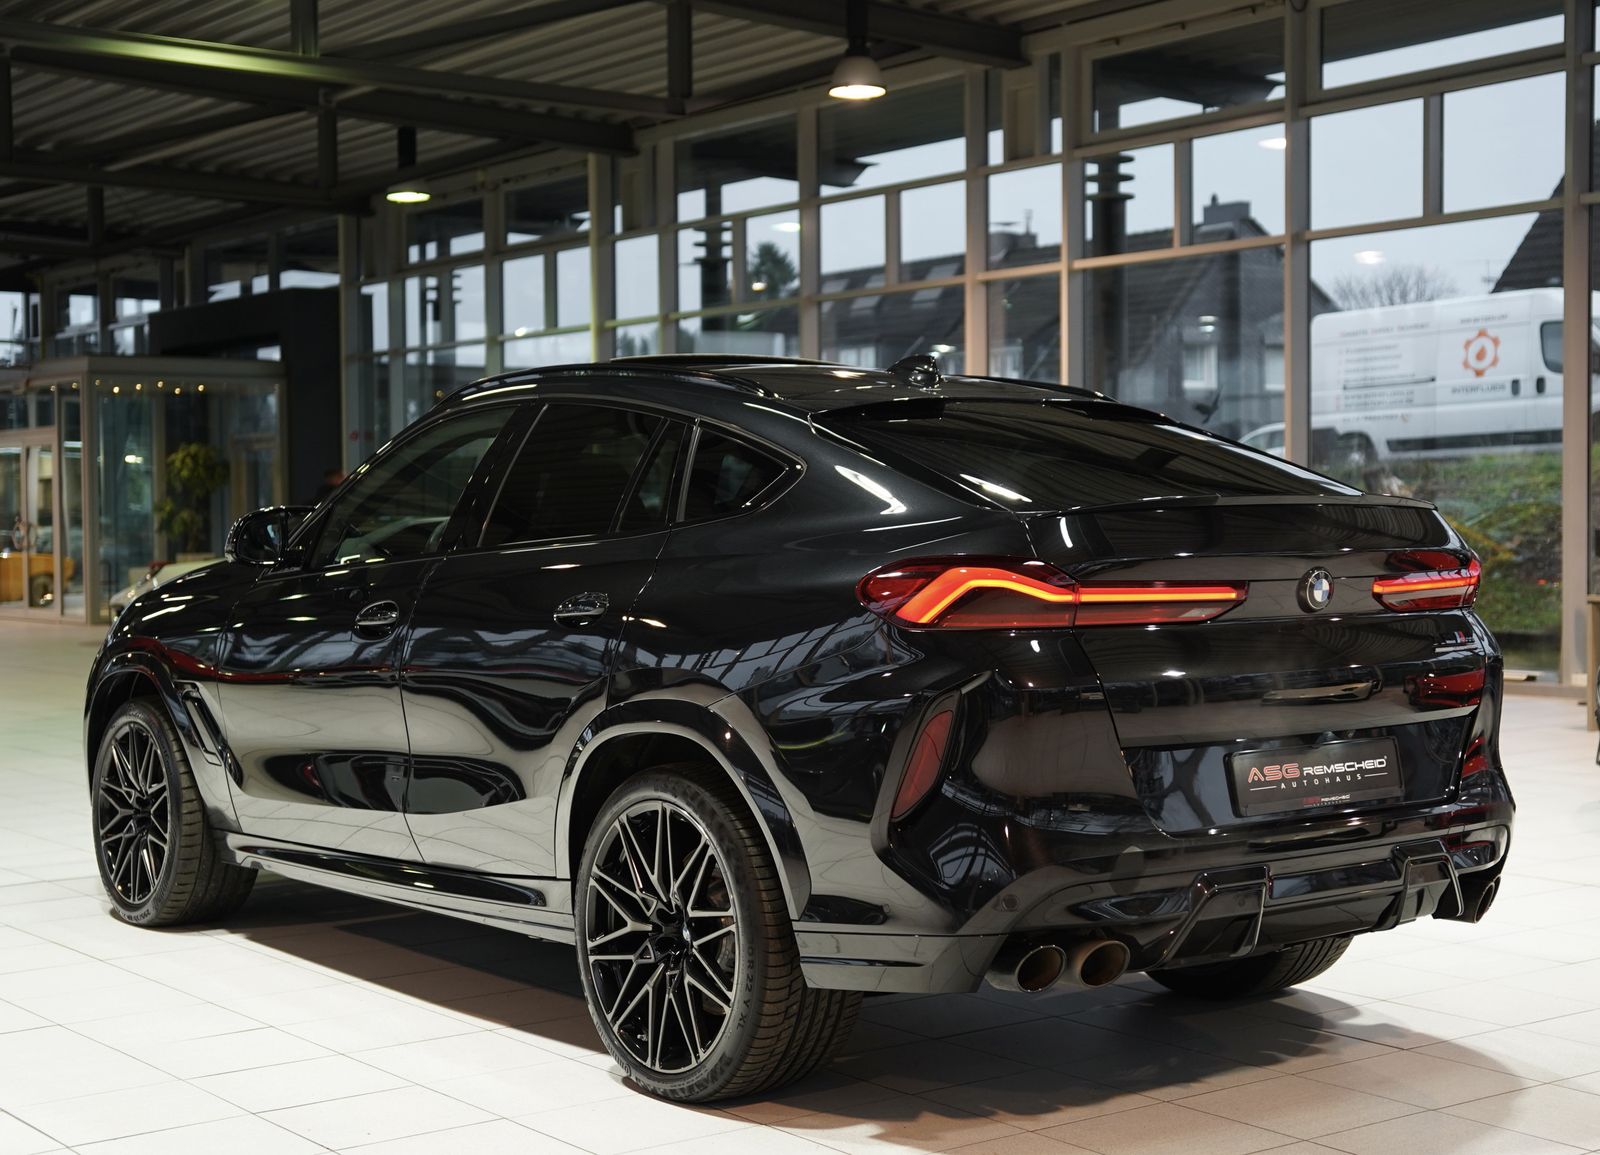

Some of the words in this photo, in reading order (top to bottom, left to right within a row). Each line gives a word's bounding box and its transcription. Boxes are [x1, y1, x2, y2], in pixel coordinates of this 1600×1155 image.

[1248, 763, 1300, 783] ASG
[1303, 758, 1387, 776] REMSCHEID
[1281, 773, 1362, 789] AUTOHAUS
